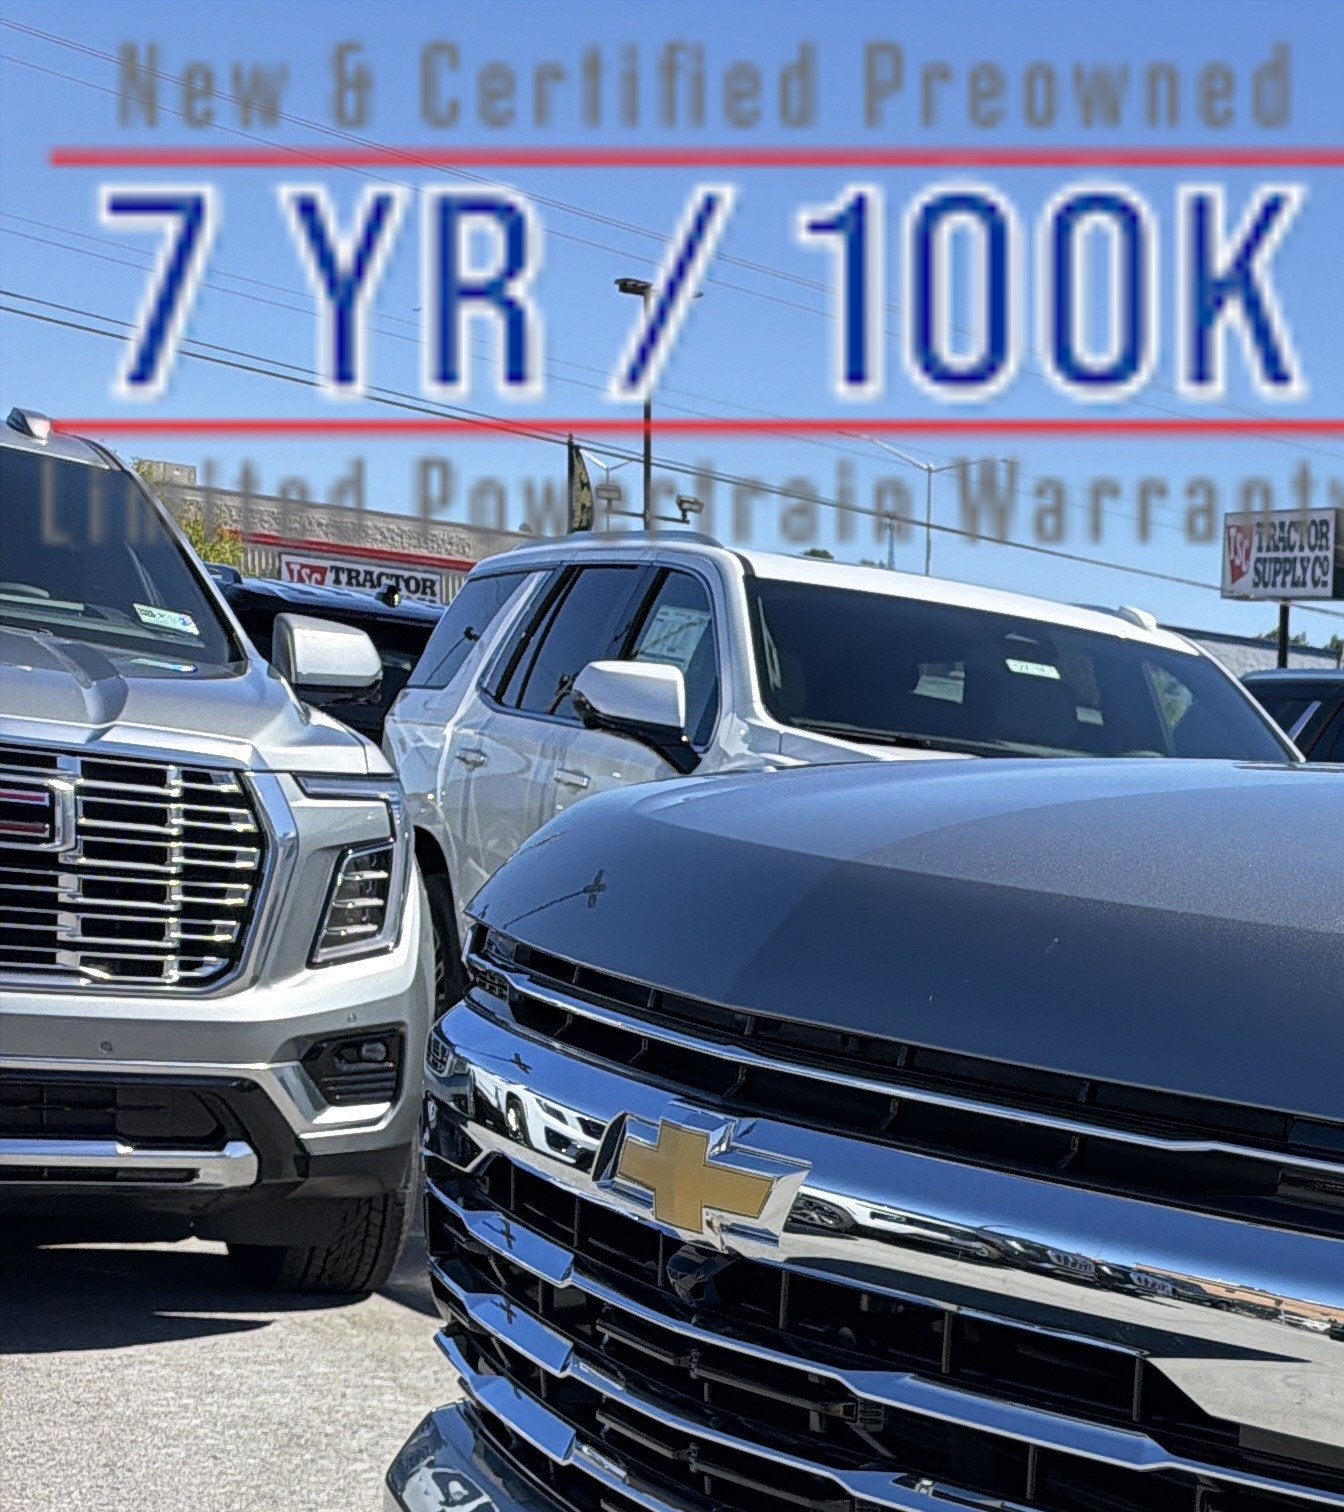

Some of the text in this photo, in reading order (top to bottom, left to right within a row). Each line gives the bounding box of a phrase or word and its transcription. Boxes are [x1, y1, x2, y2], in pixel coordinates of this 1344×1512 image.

[1255, 519, 1330, 553] TRACTOR
[330, 565, 437, 598] TRACTOR
[1252, 555, 1309, 588] SUPPLY
